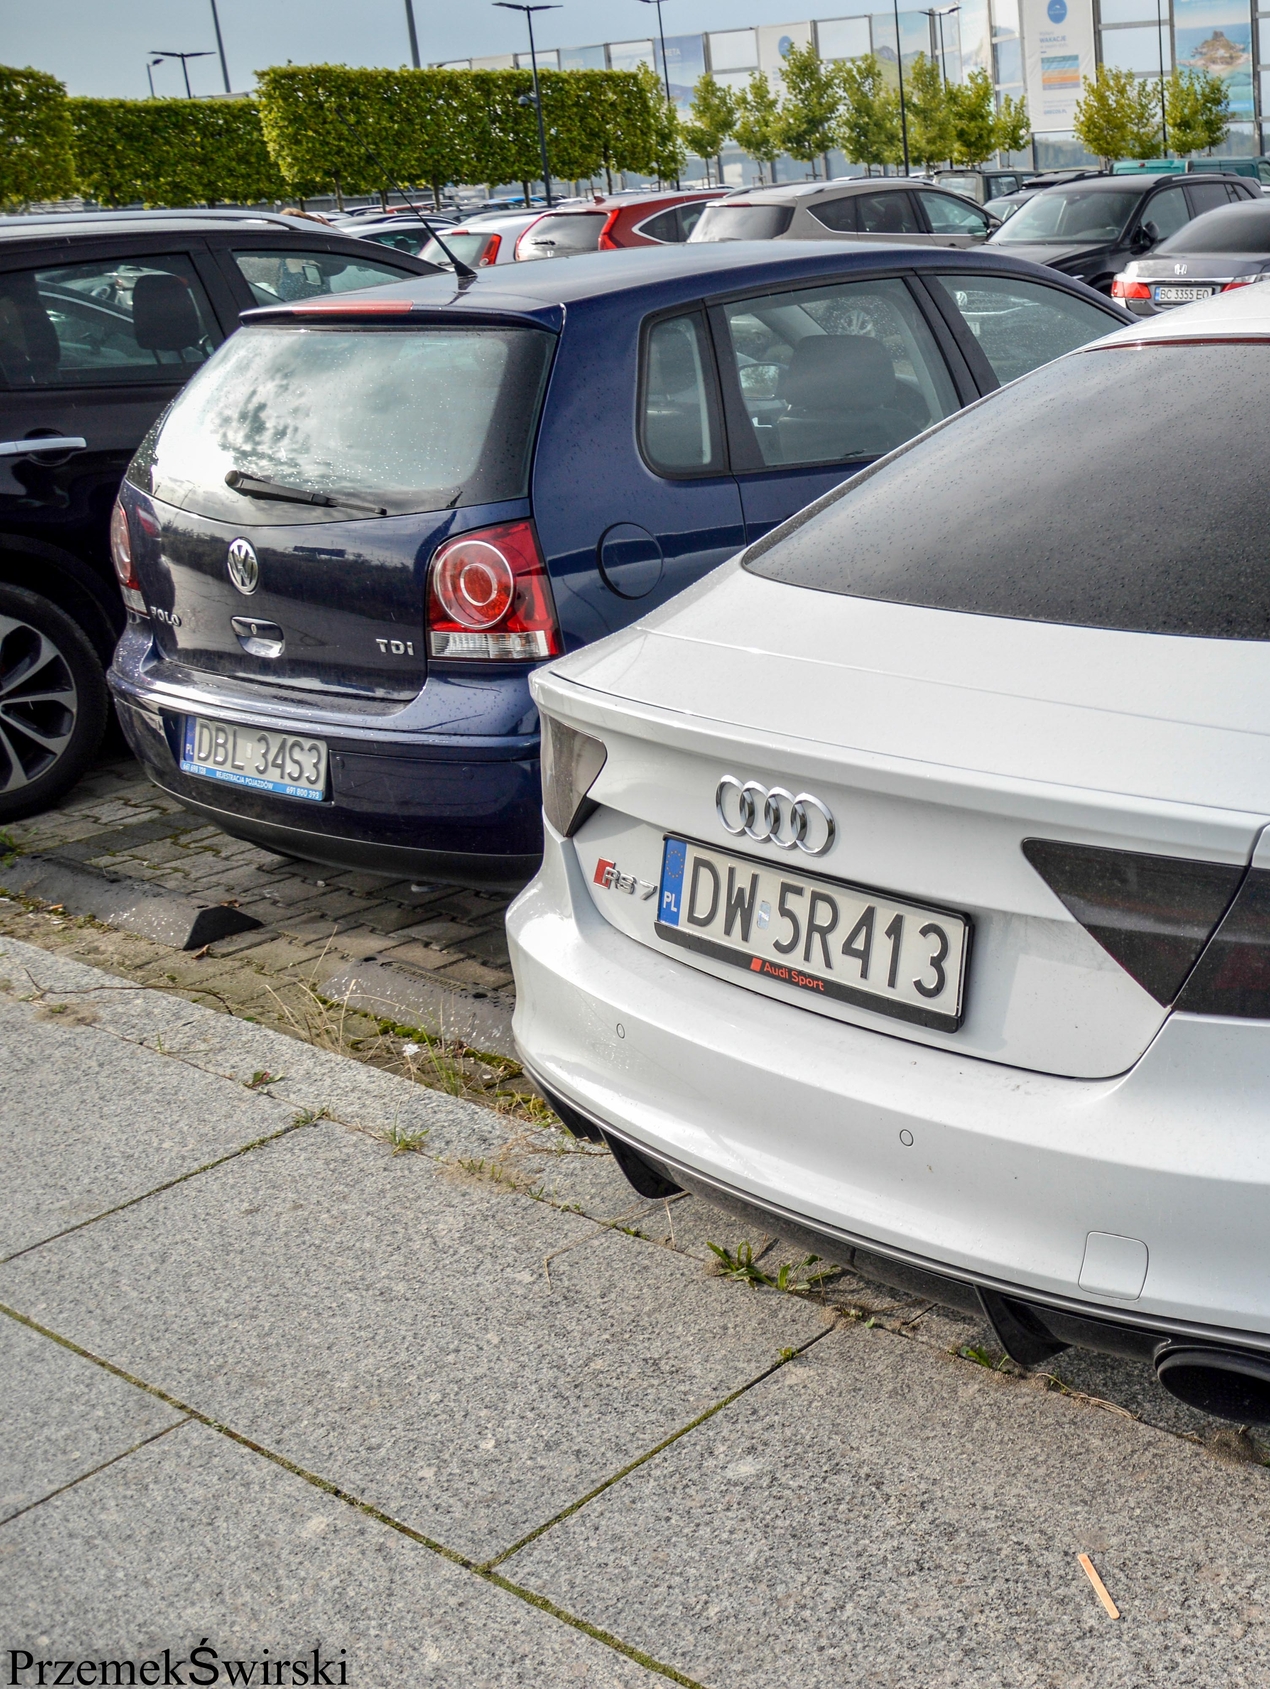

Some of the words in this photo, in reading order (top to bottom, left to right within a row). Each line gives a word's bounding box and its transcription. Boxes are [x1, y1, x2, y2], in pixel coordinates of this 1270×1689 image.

[1160, 289, 1172, 299] BC
[1174, 289, 1194, 300] 3355
[150, 606, 181, 627] POLO
[376, 638, 415, 656] TDI
[185, 743, 194, 756] PL
[197, 720, 245, 771] DBL
[254, 732, 322, 785] 34S3
[286, 785, 296, 795] 691
[663, 891, 678, 912] PL
[686, 854, 760, 943] DW
[772, 878, 950, 999] 5R413
[763, 962, 789, 979] Audi
[791, 970, 825, 991] Sport
